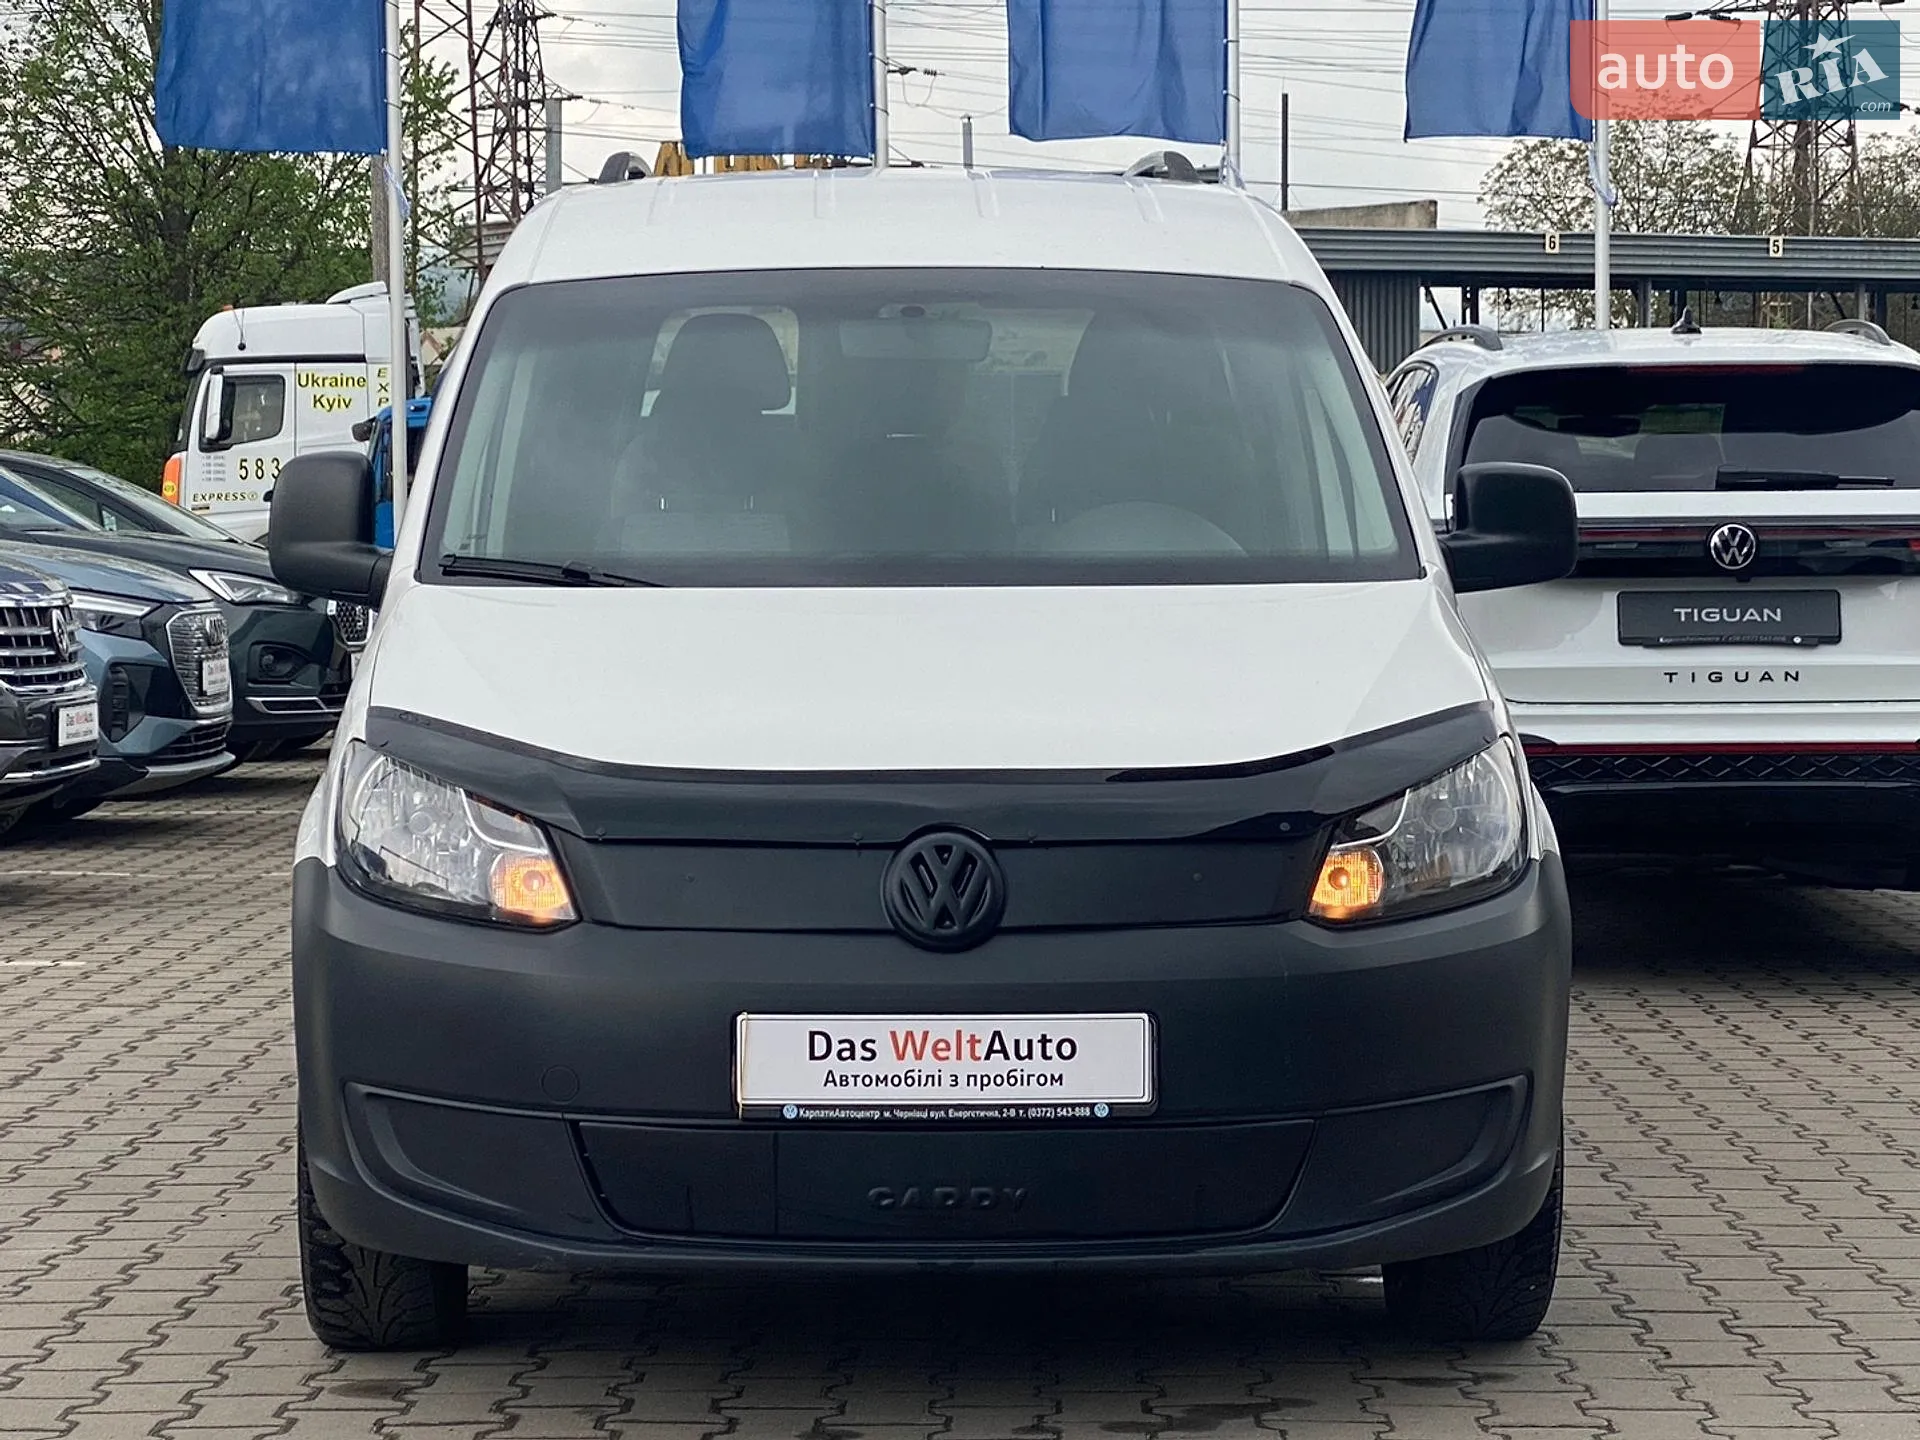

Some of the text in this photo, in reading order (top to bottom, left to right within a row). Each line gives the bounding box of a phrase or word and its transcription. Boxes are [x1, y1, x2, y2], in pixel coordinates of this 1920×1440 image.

[1548, 237, 1557, 250] 6
[1771, 240, 1781, 254] 5
[297, 372, 367, 389] Ukraine
[313, 394, 352, 412] Kyiv
[192, 492, 246, 502] EXPRESS
[1673, 608, 1782, 622] TIGUAN
[1664, 671, 1799, 683] TIGUAN
[808, 1030, 1078, 1062] Das WeltAuto
[823, 1068, 1064, 1091] Автомобілі з пробігом
[1028, 1108, 1055, 1118] (0372)
[867, 1185, 1026, 1207] CADDY
